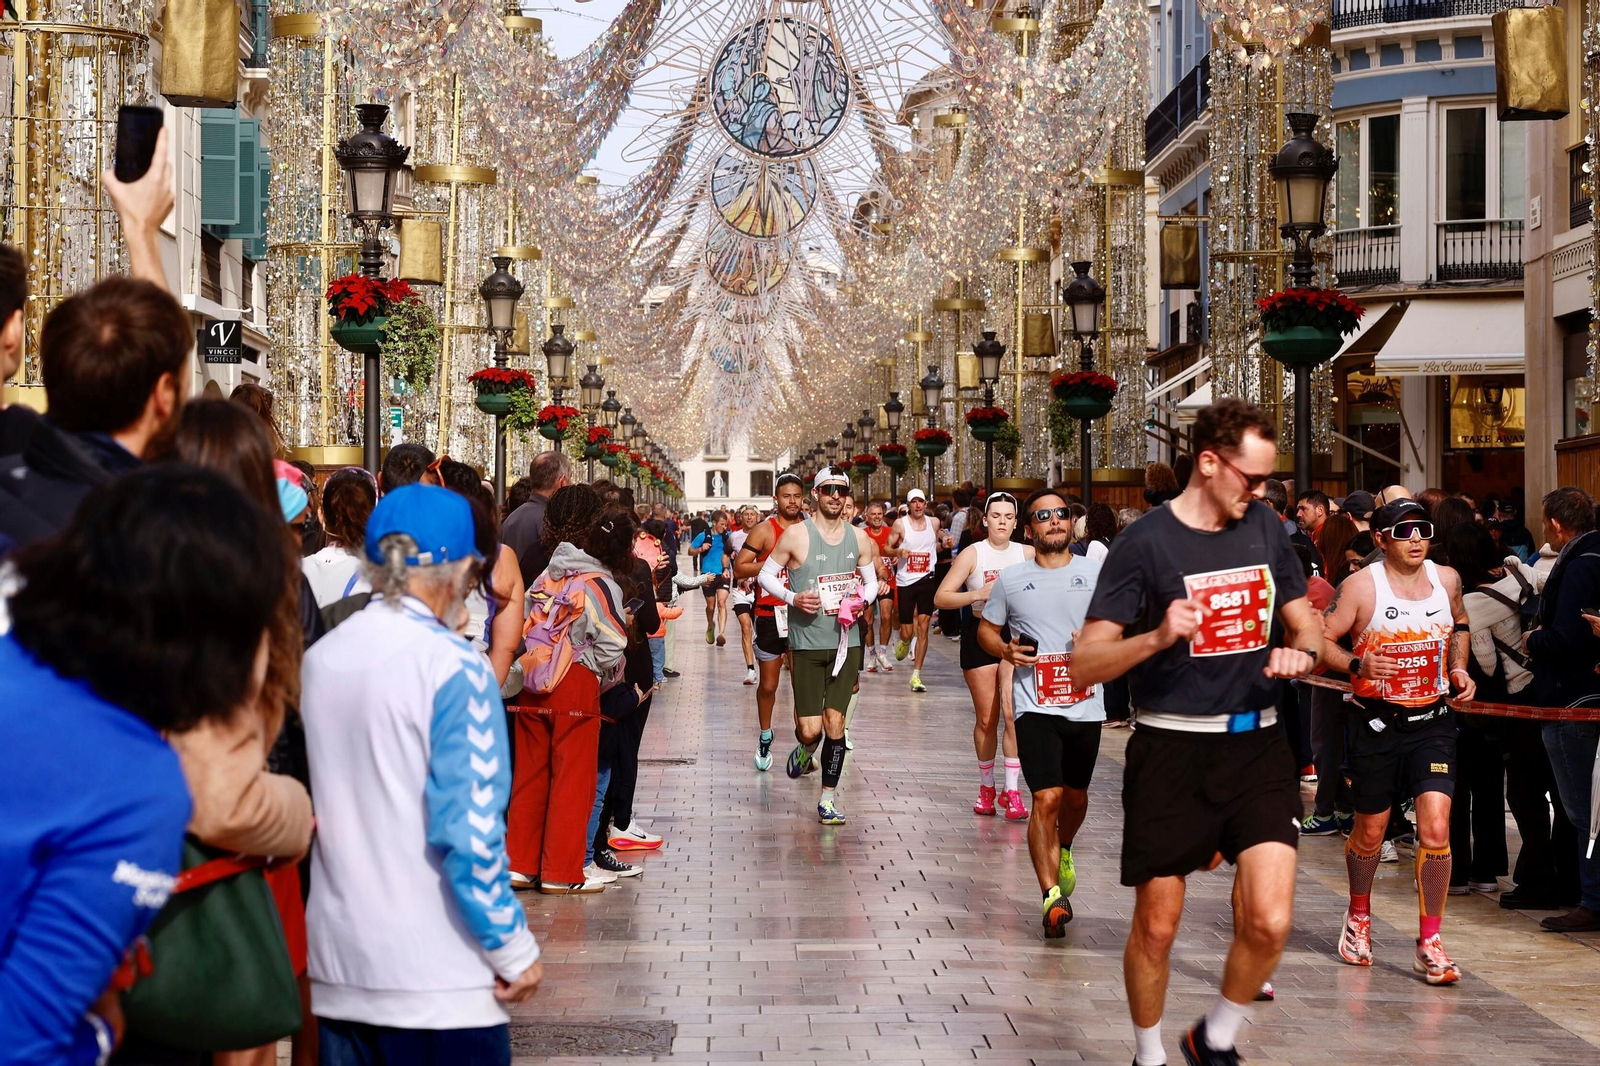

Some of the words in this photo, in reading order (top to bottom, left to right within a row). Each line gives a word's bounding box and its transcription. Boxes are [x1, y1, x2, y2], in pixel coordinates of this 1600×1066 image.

[1423, 361, 1440, 373] La
[1441, 360, 1483, 373] Canasta
[1461, 435, 1491, 444] TAKE
[1495, 434, 1525, 444] AWAY
[1209, 589, 1251, 610] 8681
[1397, 642, 1436, 653] GENERALI
[1049, 654, 1073, 663] GENE
[1397, 656, 1428, 669] 5256
[1052, 666, 1071, 677] 72
